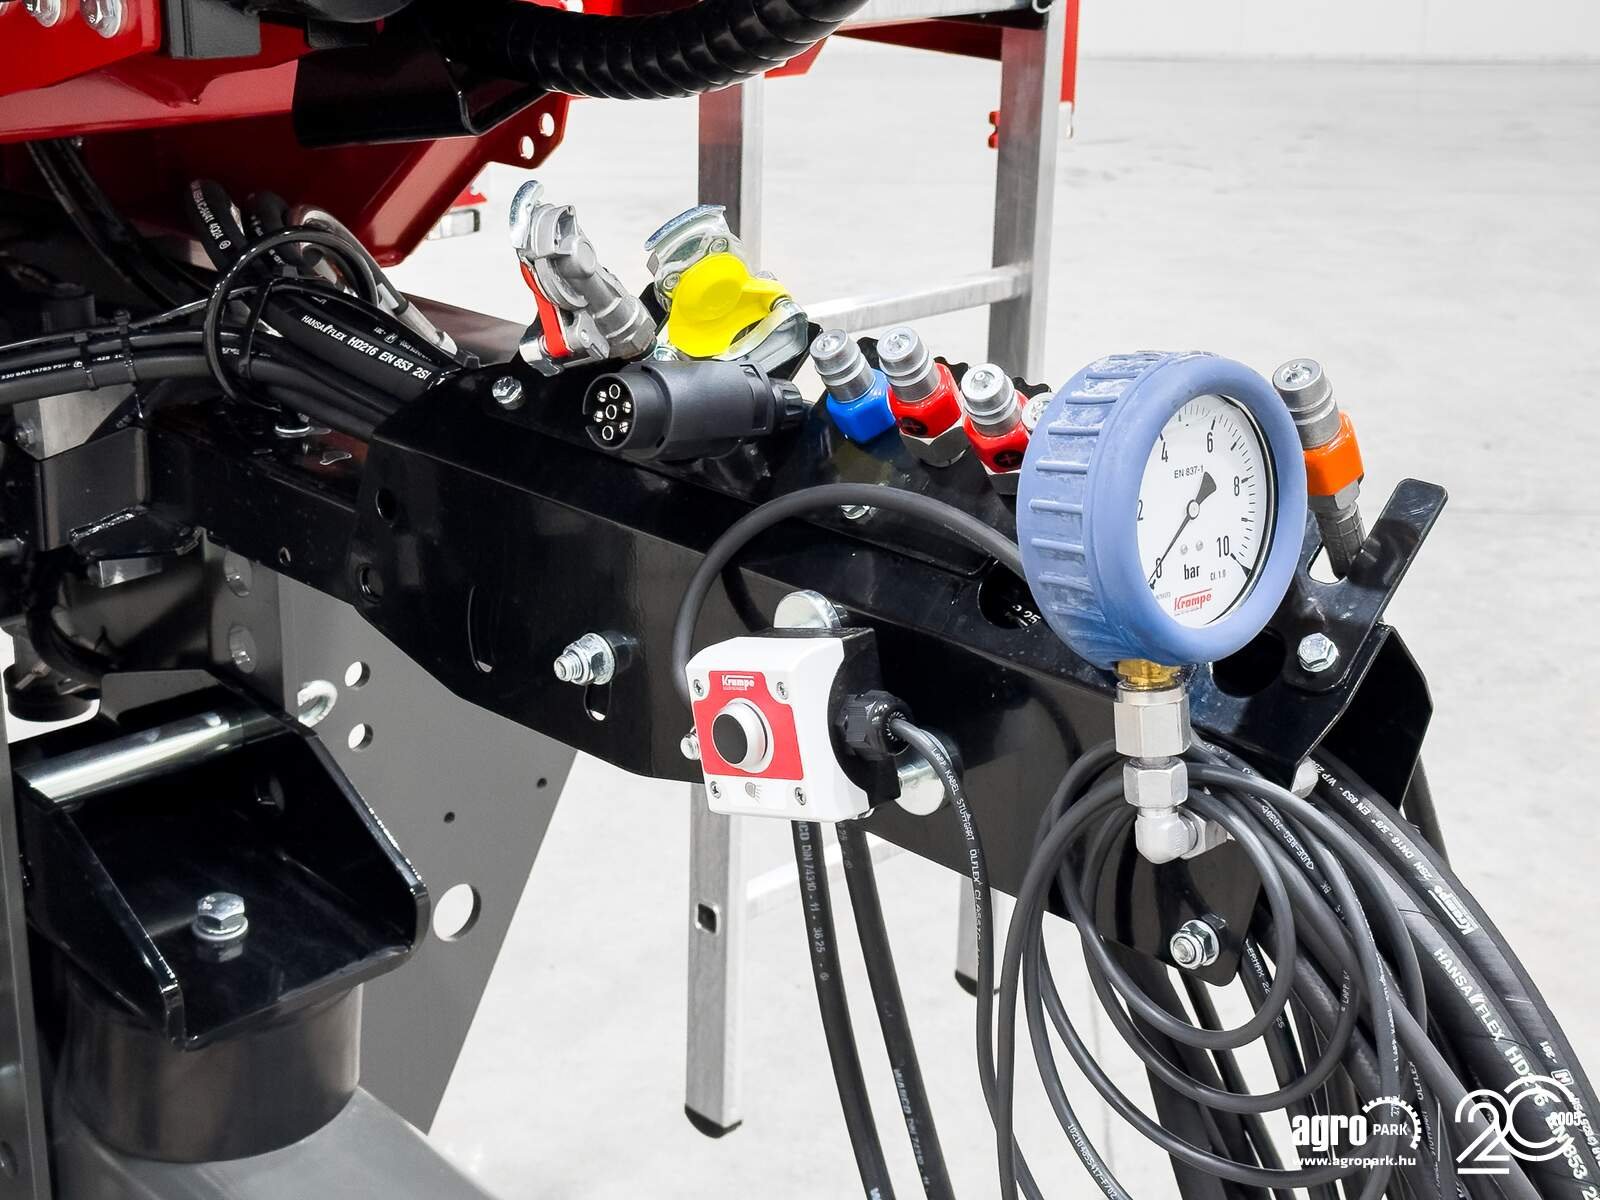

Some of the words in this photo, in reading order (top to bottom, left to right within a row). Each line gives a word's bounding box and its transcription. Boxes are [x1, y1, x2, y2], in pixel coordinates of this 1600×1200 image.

[347, 336, 380, 357] HD216
[378, 350, 397, 365] EN
[393, 357, 415, 372] 853
[1161, 441, 1169, 463] 4
[1206, 431, 1215, 453] 6
[1174, 469, 1185, 479] EN
[1185, 464, 1205, 477] 837-1
[1233, 475, 1241, 497] 8
[1216, 535, 1230, 558] 10
[1155, 557, 1163, 579] 0
[1183, 563, 1201, 581] bar
[1174, 587, 1213, 611] Krampe
[721, 674, 755, 691] Krampe
[945, 769, 960, 796] KABEL
[802, 844, 814, 862] DIN
[1428, 885, 1479, 935] Krampe
